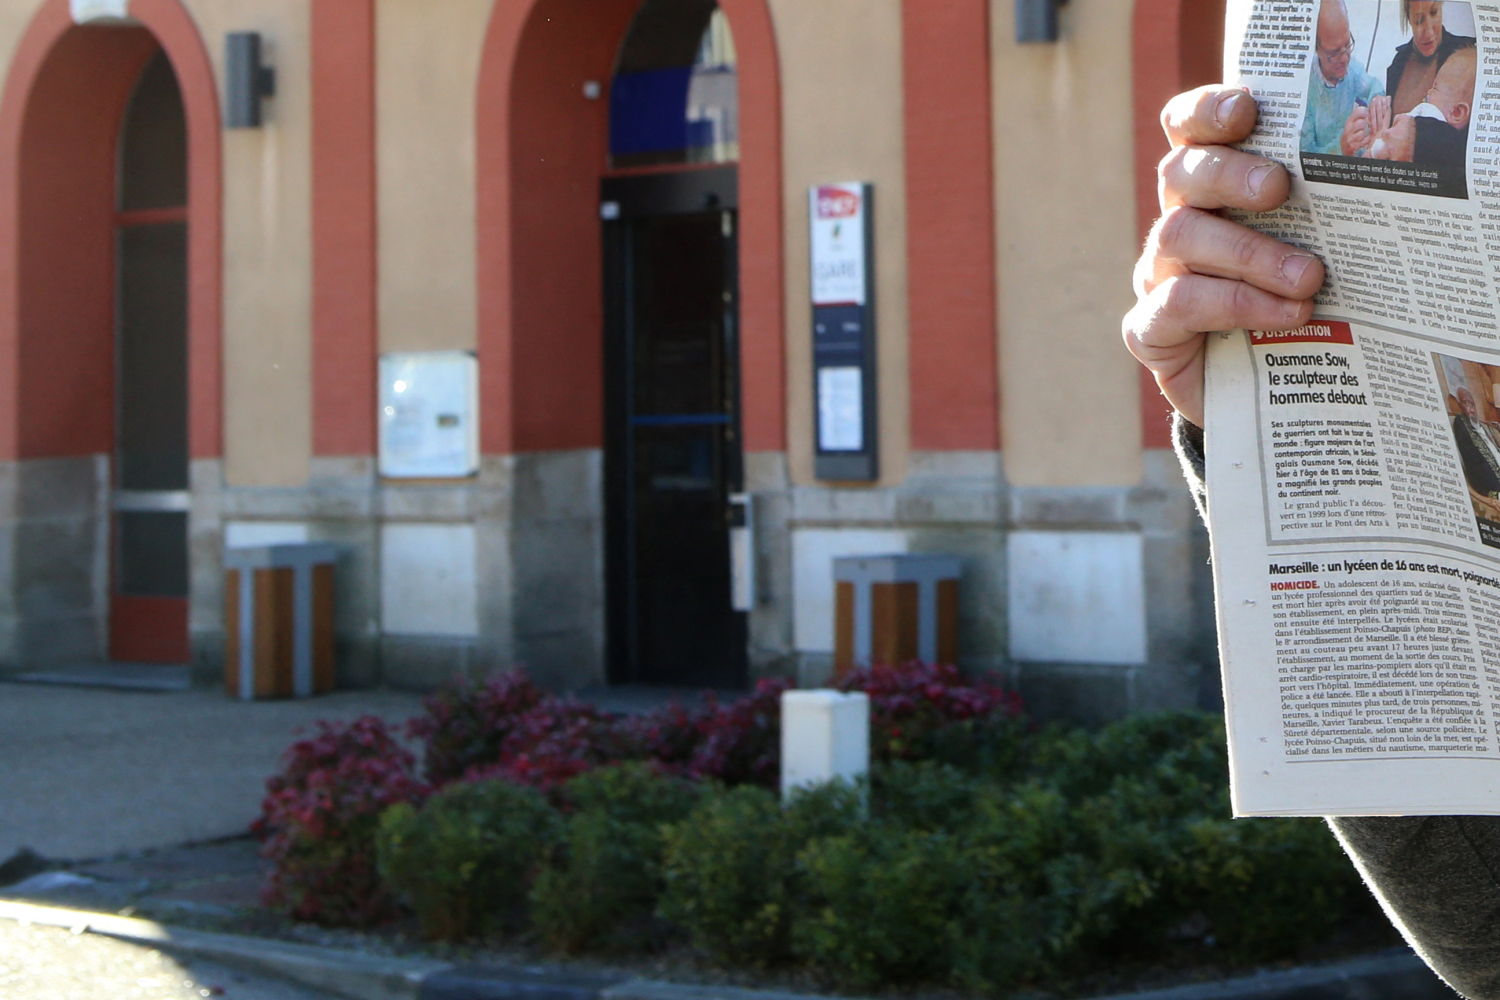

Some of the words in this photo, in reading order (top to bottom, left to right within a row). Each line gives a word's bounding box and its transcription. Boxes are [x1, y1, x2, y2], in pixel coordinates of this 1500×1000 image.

[1266, 325, 1331, 338] DISPARITION
[1265, 353, 1323, 367] Ousmane
[1325, 352, 1350, 370] Sow,
[1268, 371, 1281, 386] le
[1283, 369, 1338, 388] sculpteur
[1340, 371, 1359, 386] des
[1269, 390, 1325, 405] hommes
[1327, 389, 1367, 406] debout
[1269, 561, 1319, 575] Marseille
[1327, 563, 1342, 572] un
[1343, 559, 1379, 575] lycéen
[1380, 559, 1394, 571] de
[1395, 560, 1407, 571] 16
[1408, 563, 1426, 572] ans
[1426, 564, 1440, 574] est
[1440, 566, 1463, 580] mort,
[1463, 571, 1500, 589] poignardé
[1270, 580, 1320, 591] HOMICIDE.
